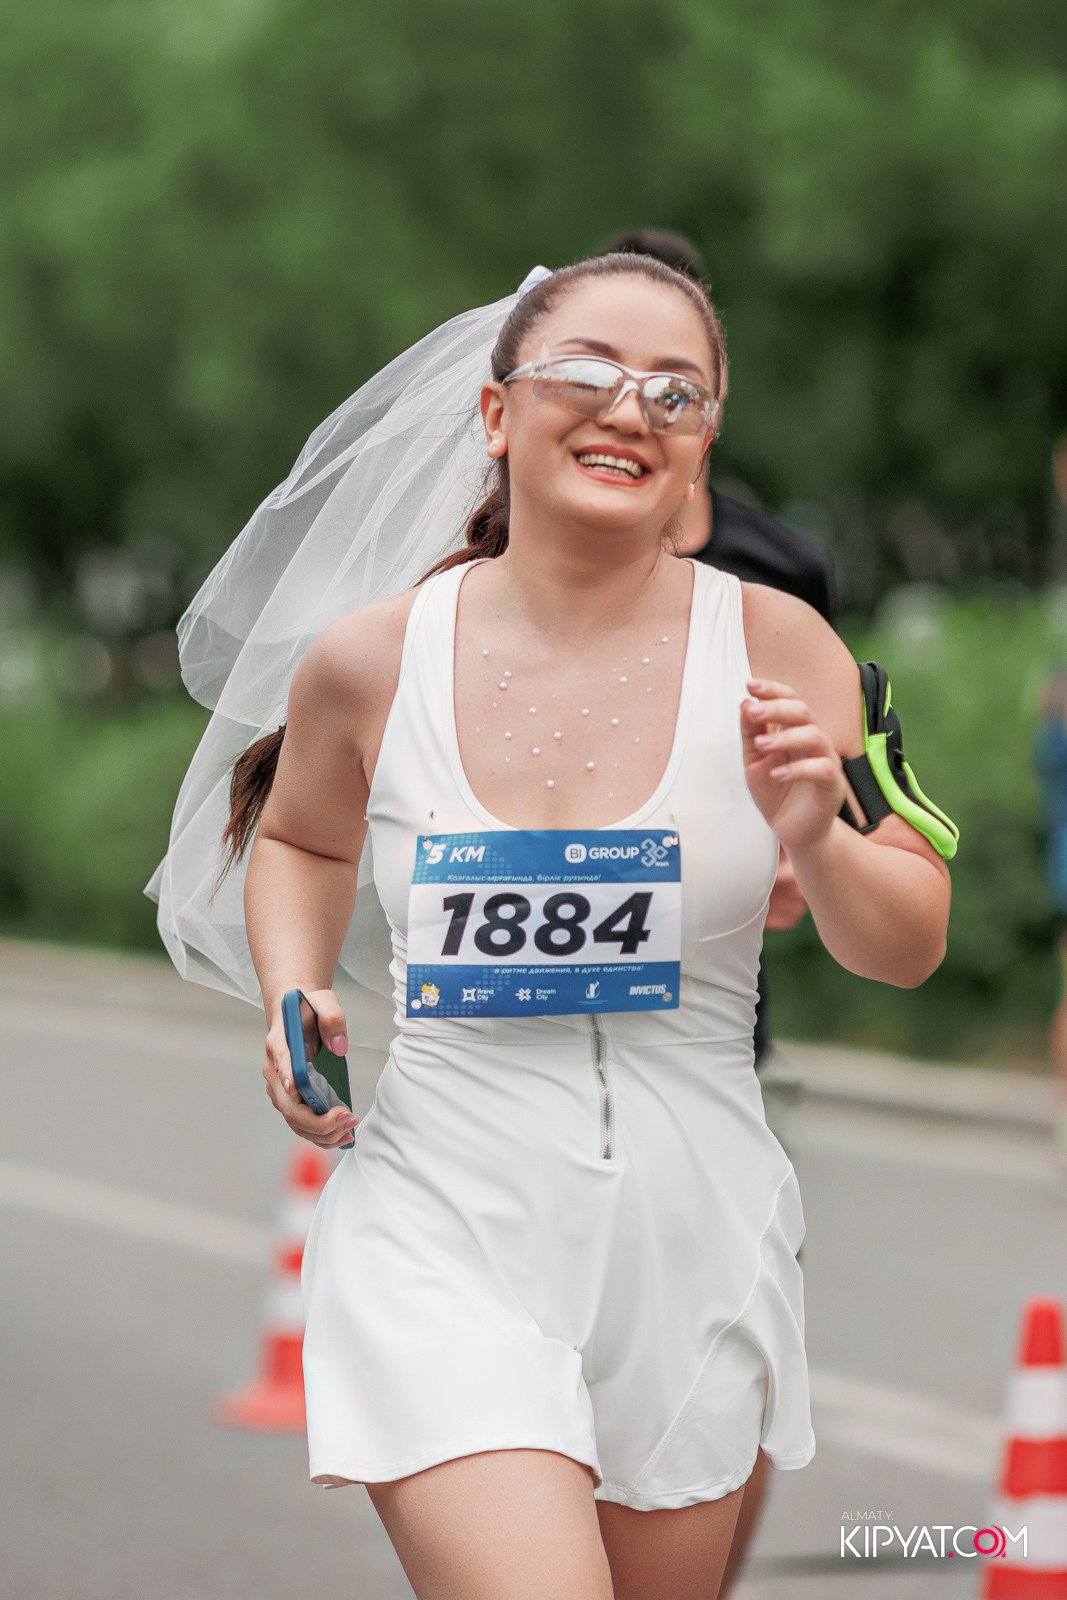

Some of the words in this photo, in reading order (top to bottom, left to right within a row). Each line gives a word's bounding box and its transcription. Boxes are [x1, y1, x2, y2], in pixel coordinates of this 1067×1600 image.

[425, 843, 447, 865] 5
[588, 846, 640, 860] GROUP
[440, 891, 654, 957] 1884
[501, 967, 528, 975] ритме
[629, 984, 667, 996] INVICTUS
[477, 994, 489, 1002] City
